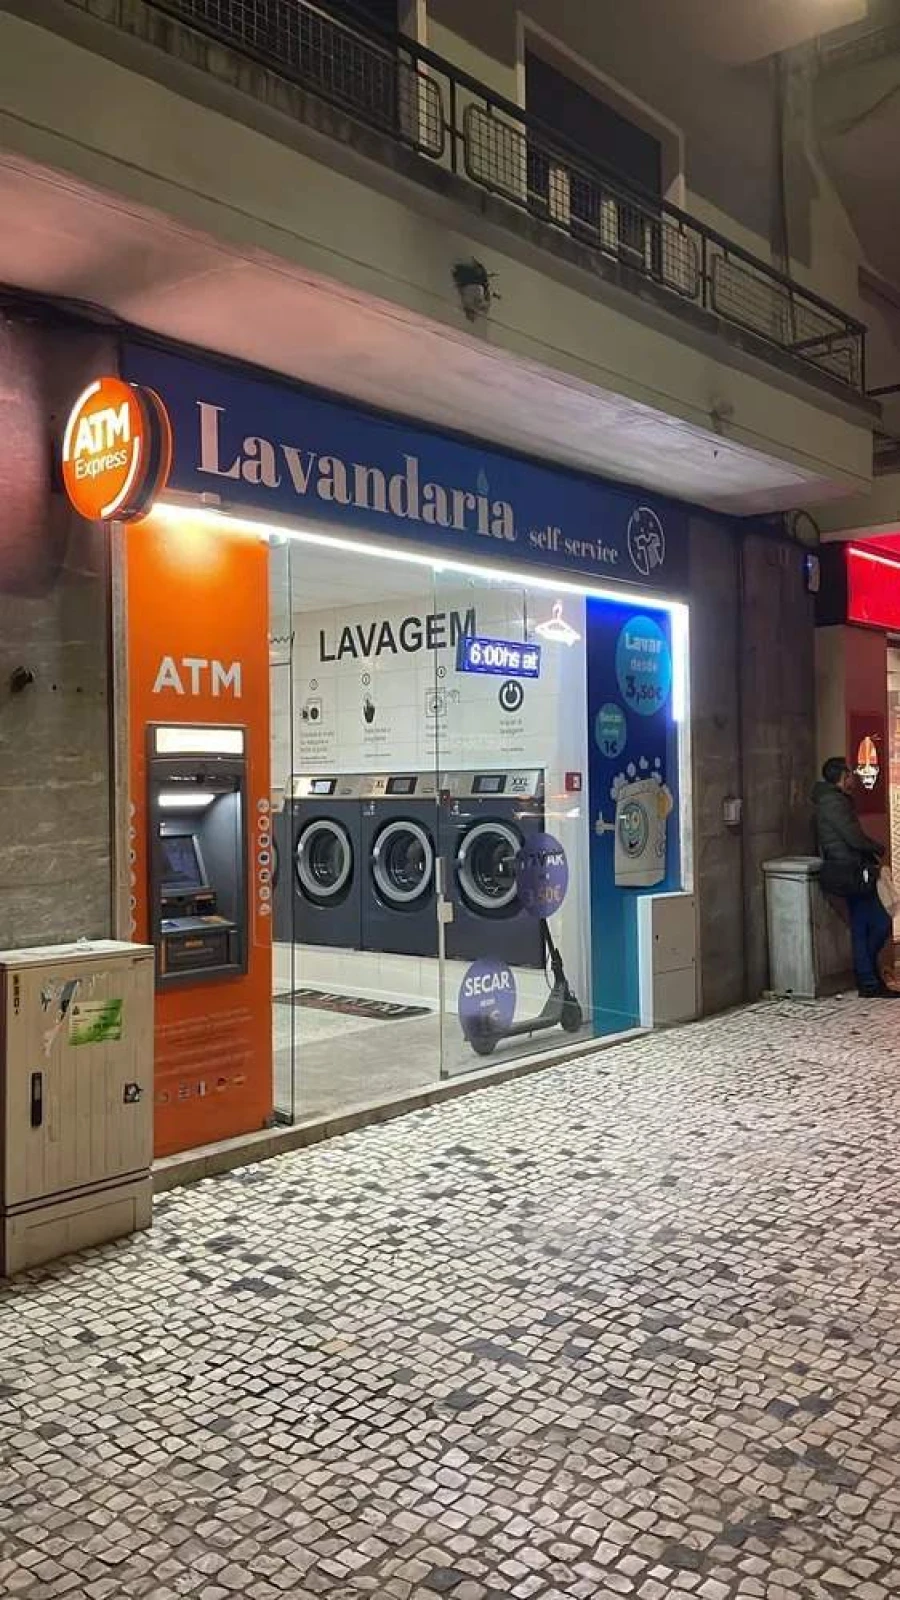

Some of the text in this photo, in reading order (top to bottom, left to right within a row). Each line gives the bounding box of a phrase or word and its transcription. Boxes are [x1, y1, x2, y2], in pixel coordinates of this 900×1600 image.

[73, 402, 131, 459] ATM
[75, 450, 127, 479] Express
[196, 400, 517, 542] Lavandaria
[319, 607, 476, 662] LAVAGEM
[626, 632, 661, 653] Lavar
[470, 643, 519, 668] 6:00hs
[152, 656, 242, 697] ATM
[465, 971, 511, 997] SECAR
